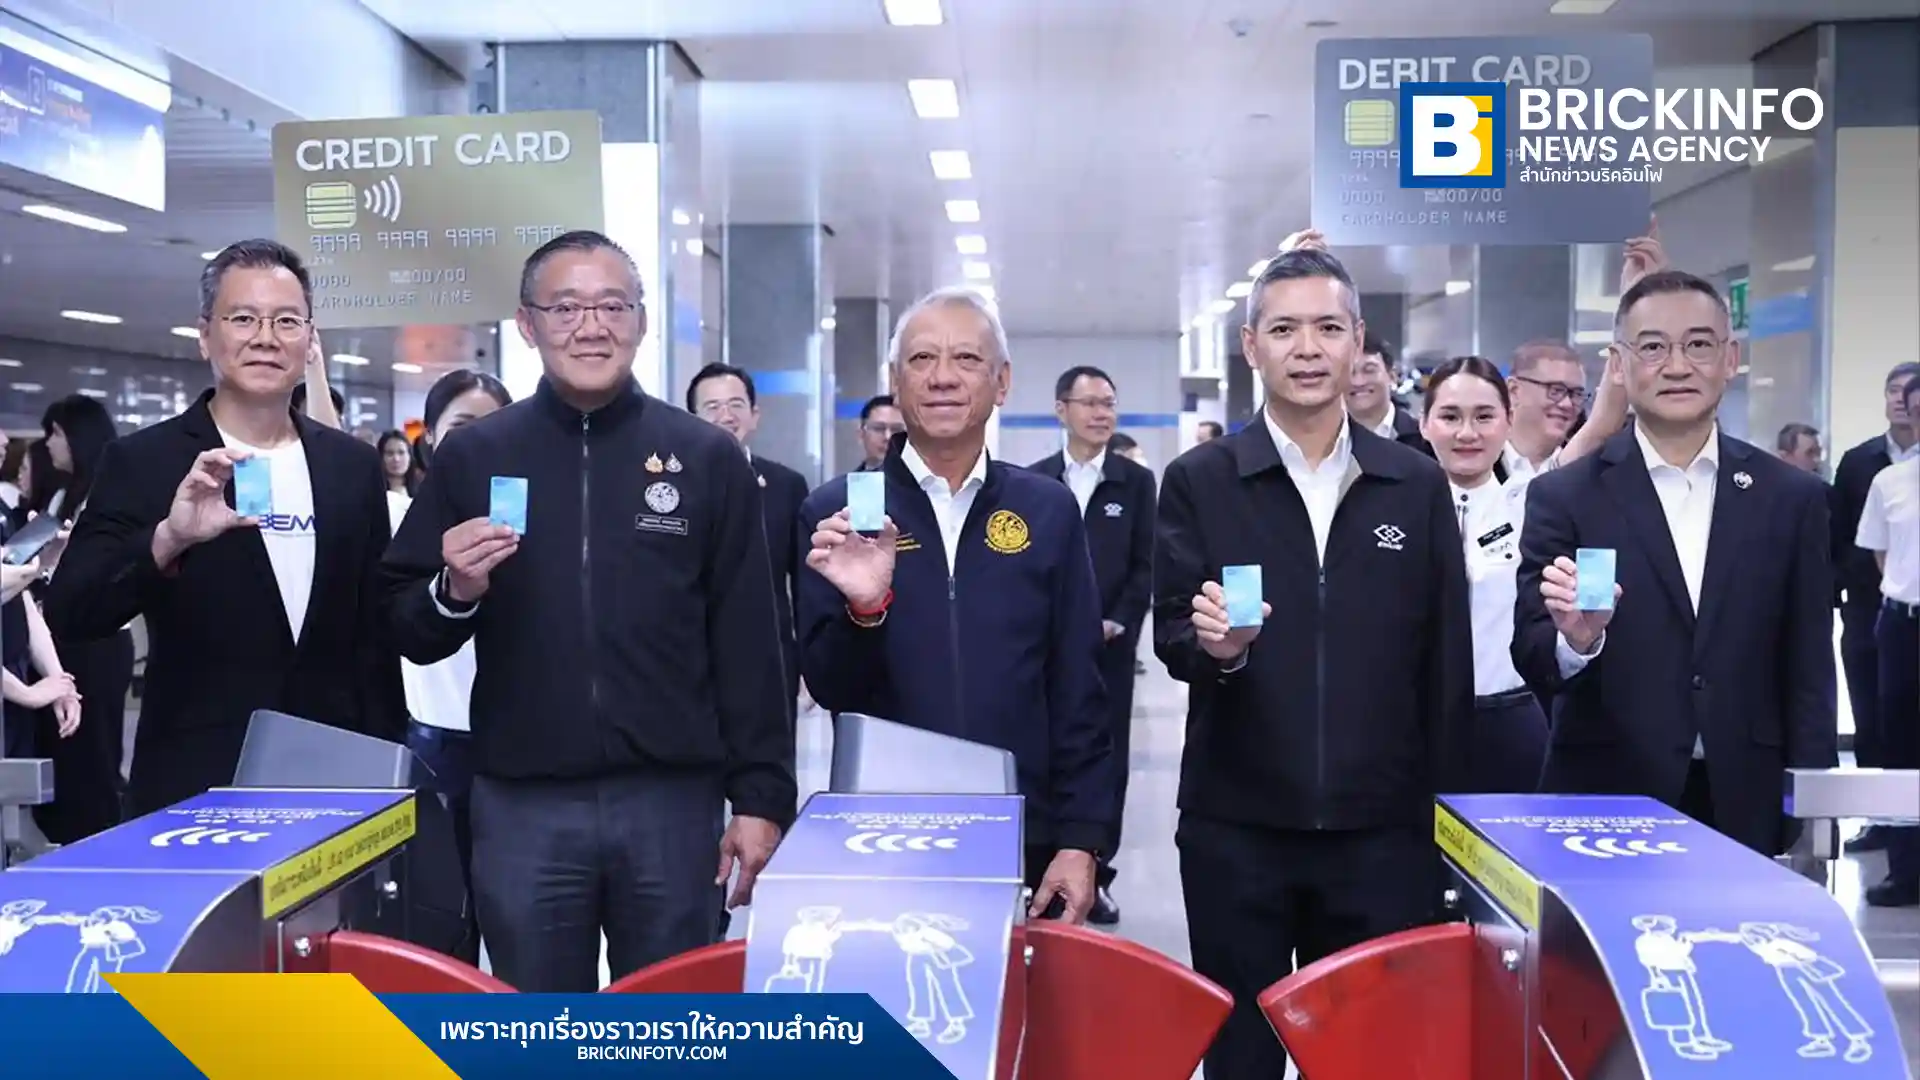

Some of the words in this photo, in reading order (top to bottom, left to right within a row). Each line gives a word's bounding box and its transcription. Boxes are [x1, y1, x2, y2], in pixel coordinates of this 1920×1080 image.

[1339, 56, 1456, 90] DEBIT
[1472, 54, 1591, 86] CARD
[296, 136, 439, 171] CREDIT
[455, 129, 571, 165] CARD
[1342, 210, 1451, 227] CARDHOLDER
[1463, 210, 1507, 226] NAME
[311, 233, 360, 251] 9999
[377, 231, 428, 249] 9999
[446, 228, 497, 247] 9999
